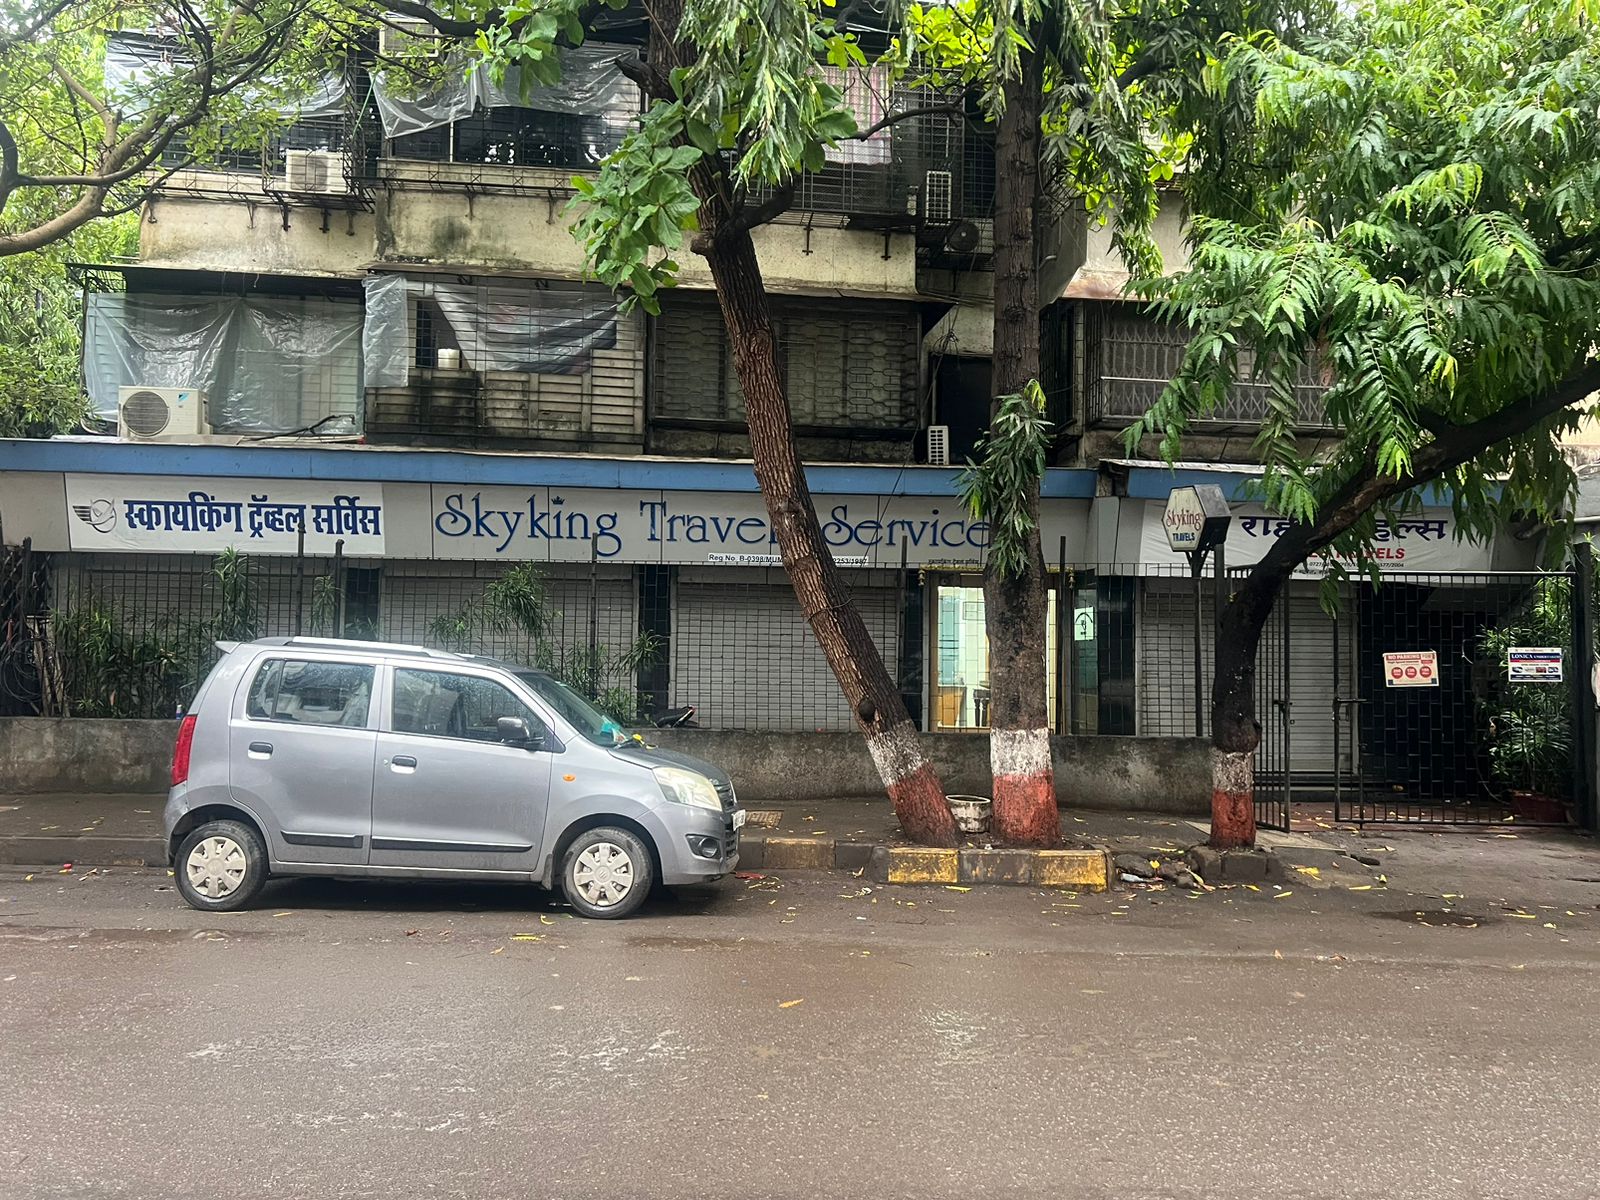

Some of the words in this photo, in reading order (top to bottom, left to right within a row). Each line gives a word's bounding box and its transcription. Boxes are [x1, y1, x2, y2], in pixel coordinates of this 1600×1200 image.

[123, 491, 242, 532] स्कायकिंग
[311, 495, 381, 536] सर्विस
[435, 492, 622, 557] Skyking
[1166, 508, 1202, 531] Skyking
[708, 553, 724, 562] Reg
